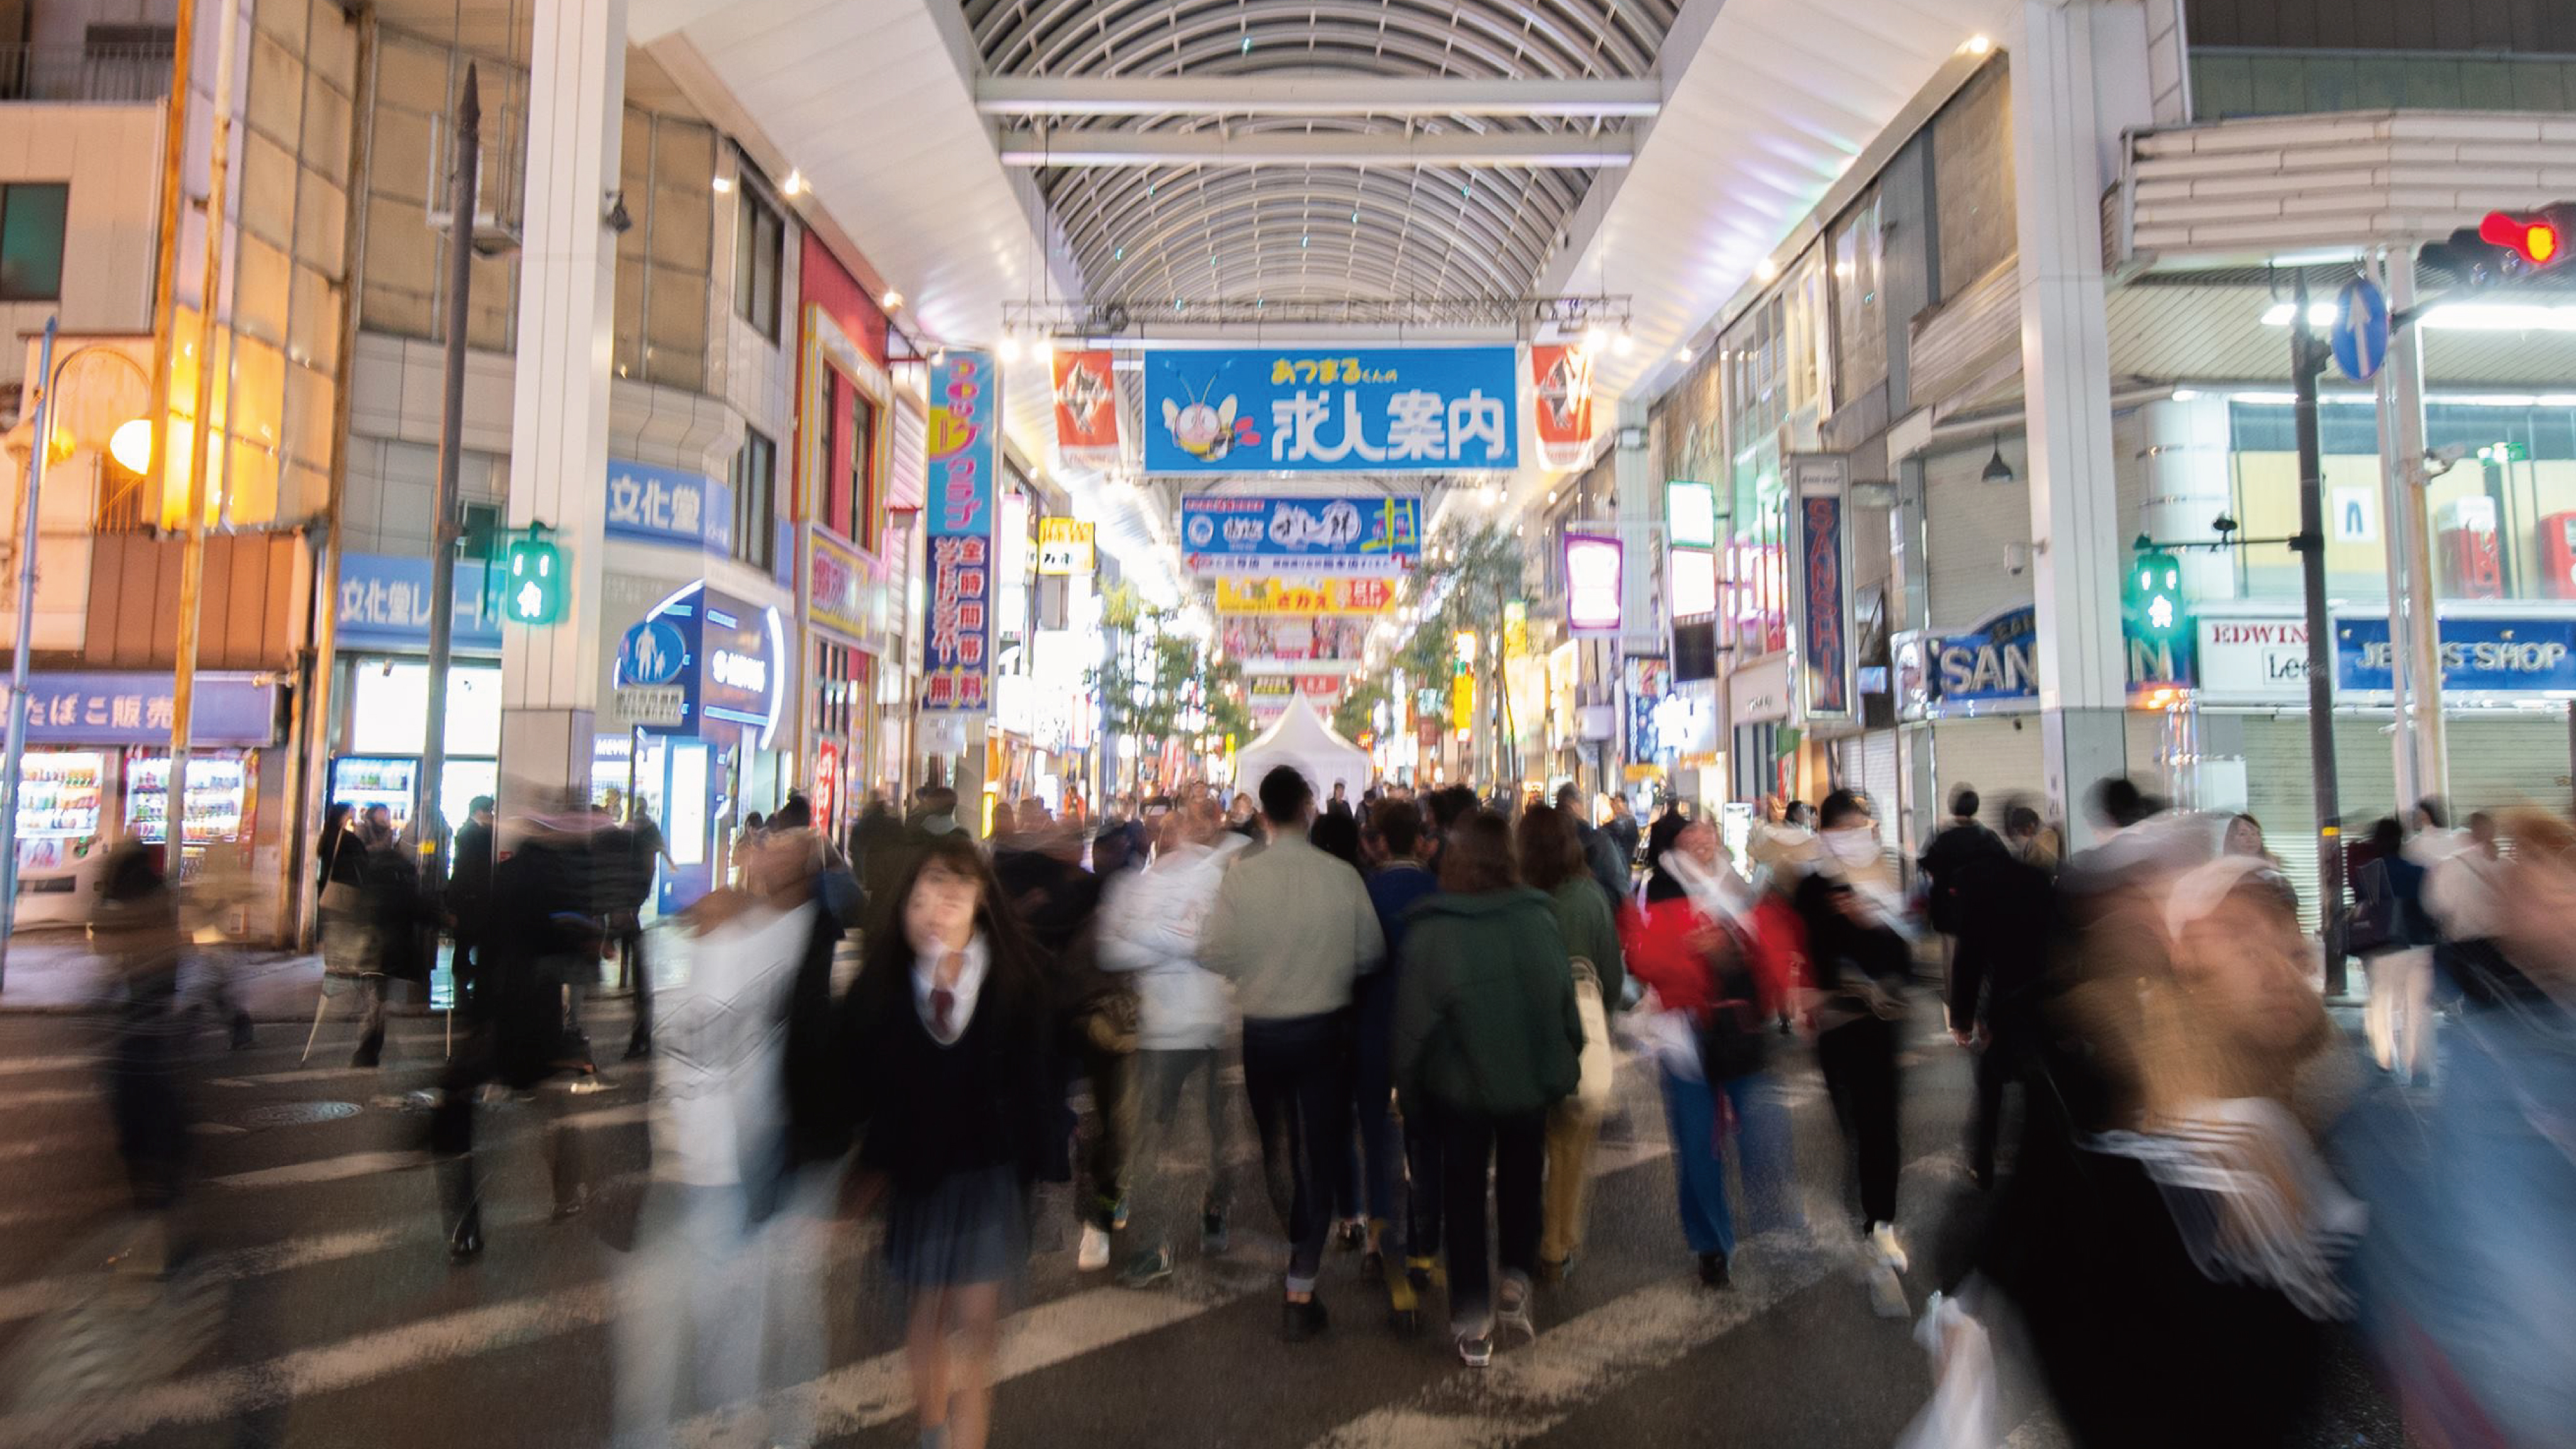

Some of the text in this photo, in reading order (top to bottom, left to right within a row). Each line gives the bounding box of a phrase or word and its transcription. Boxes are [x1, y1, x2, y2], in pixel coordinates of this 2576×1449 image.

[1271, 358, 1398, 386] あつまるくんの
[1271, 388, 1506, 462] 求人案内
[609, 473, 700, 534] 文化堂
[2355, 640, 2567, 671] JES SHOP
[928, 668, 982, 706] 無料
